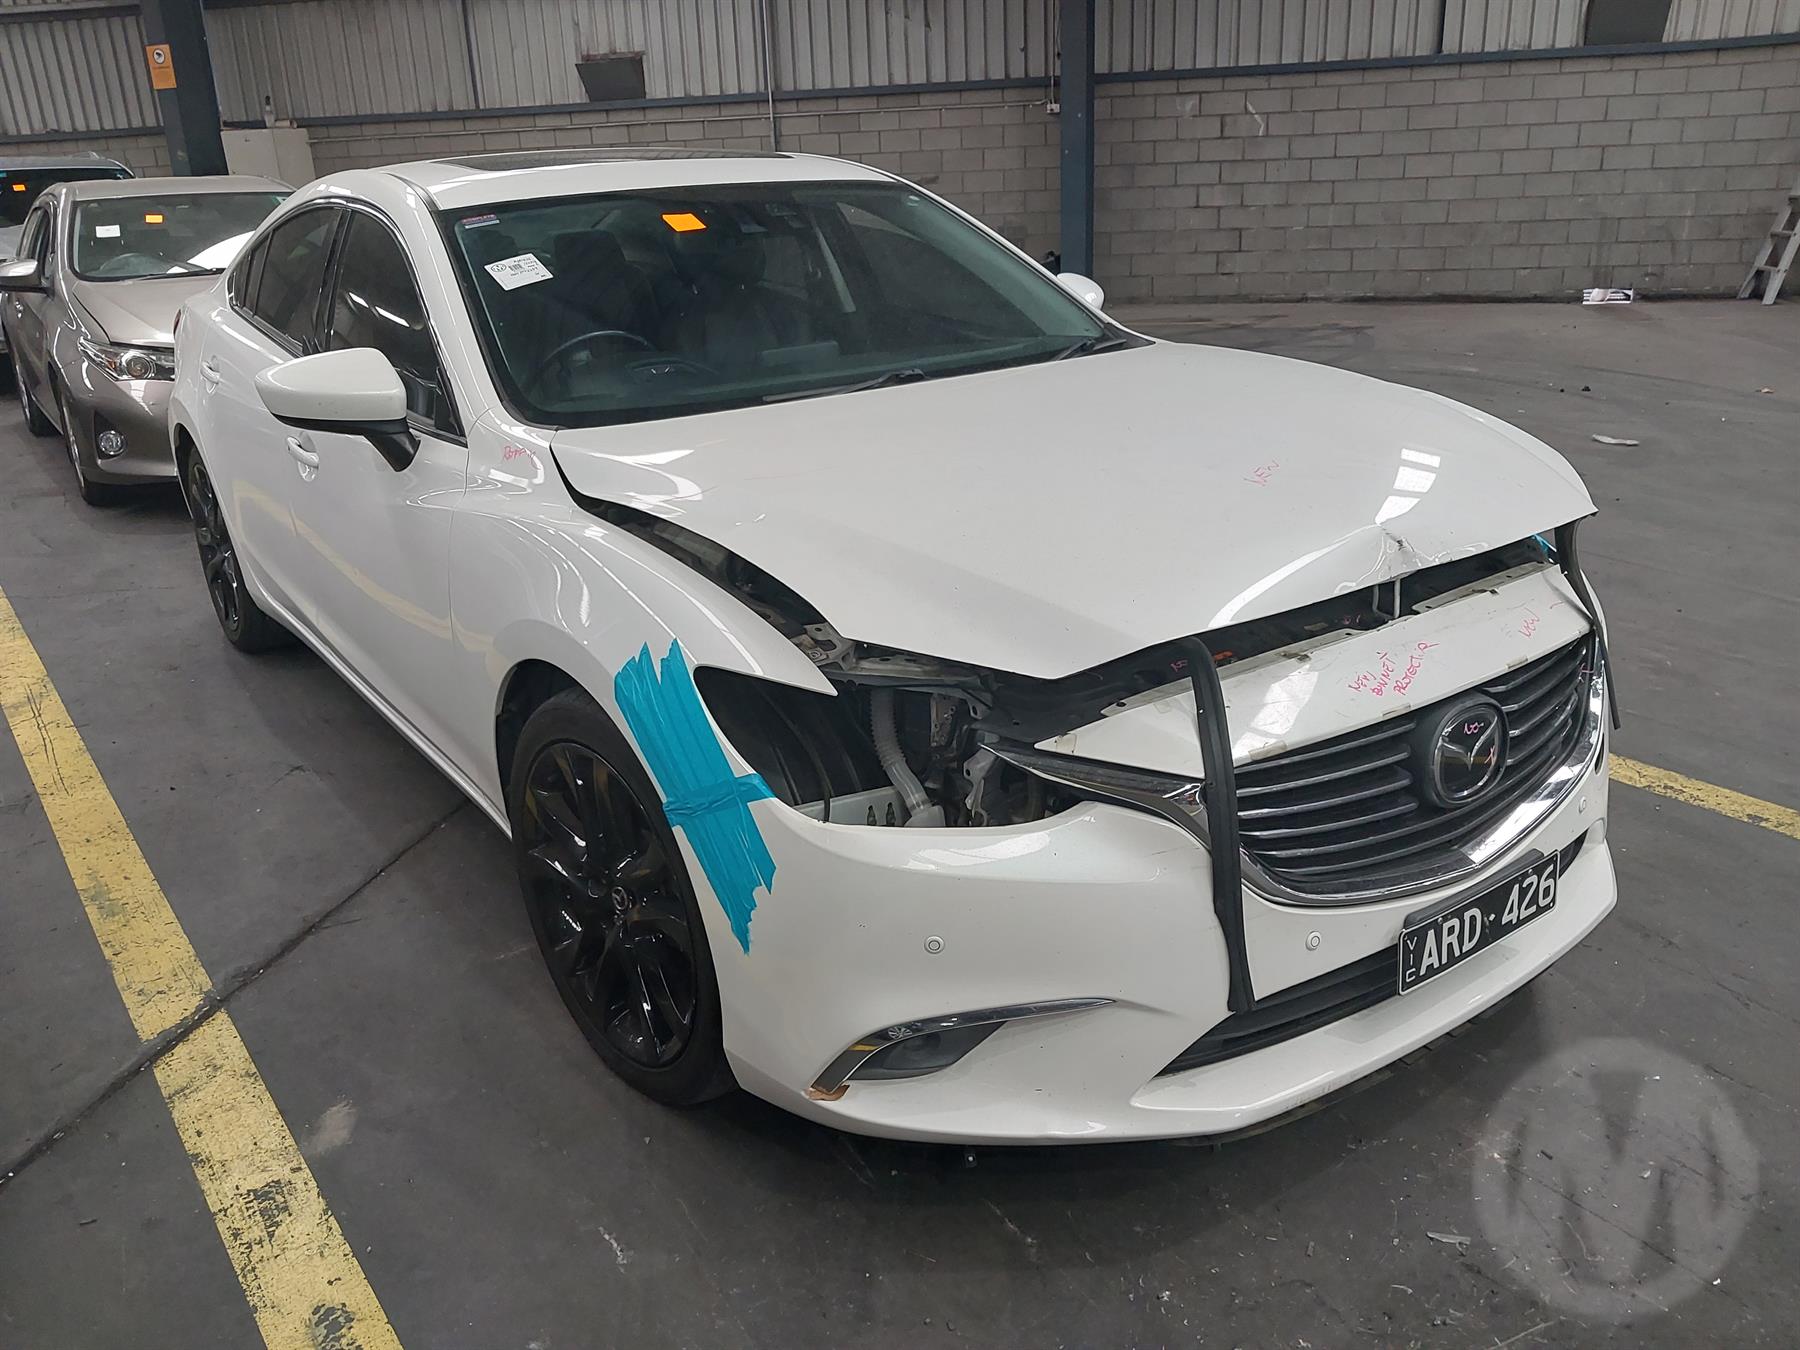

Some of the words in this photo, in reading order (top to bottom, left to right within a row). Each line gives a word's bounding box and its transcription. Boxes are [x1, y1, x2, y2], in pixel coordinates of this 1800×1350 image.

[1405, 936, 1418, 983] VIC
[1419, 907, 1483, 976] ARD
[1501, 863, 1556, 926] 426
